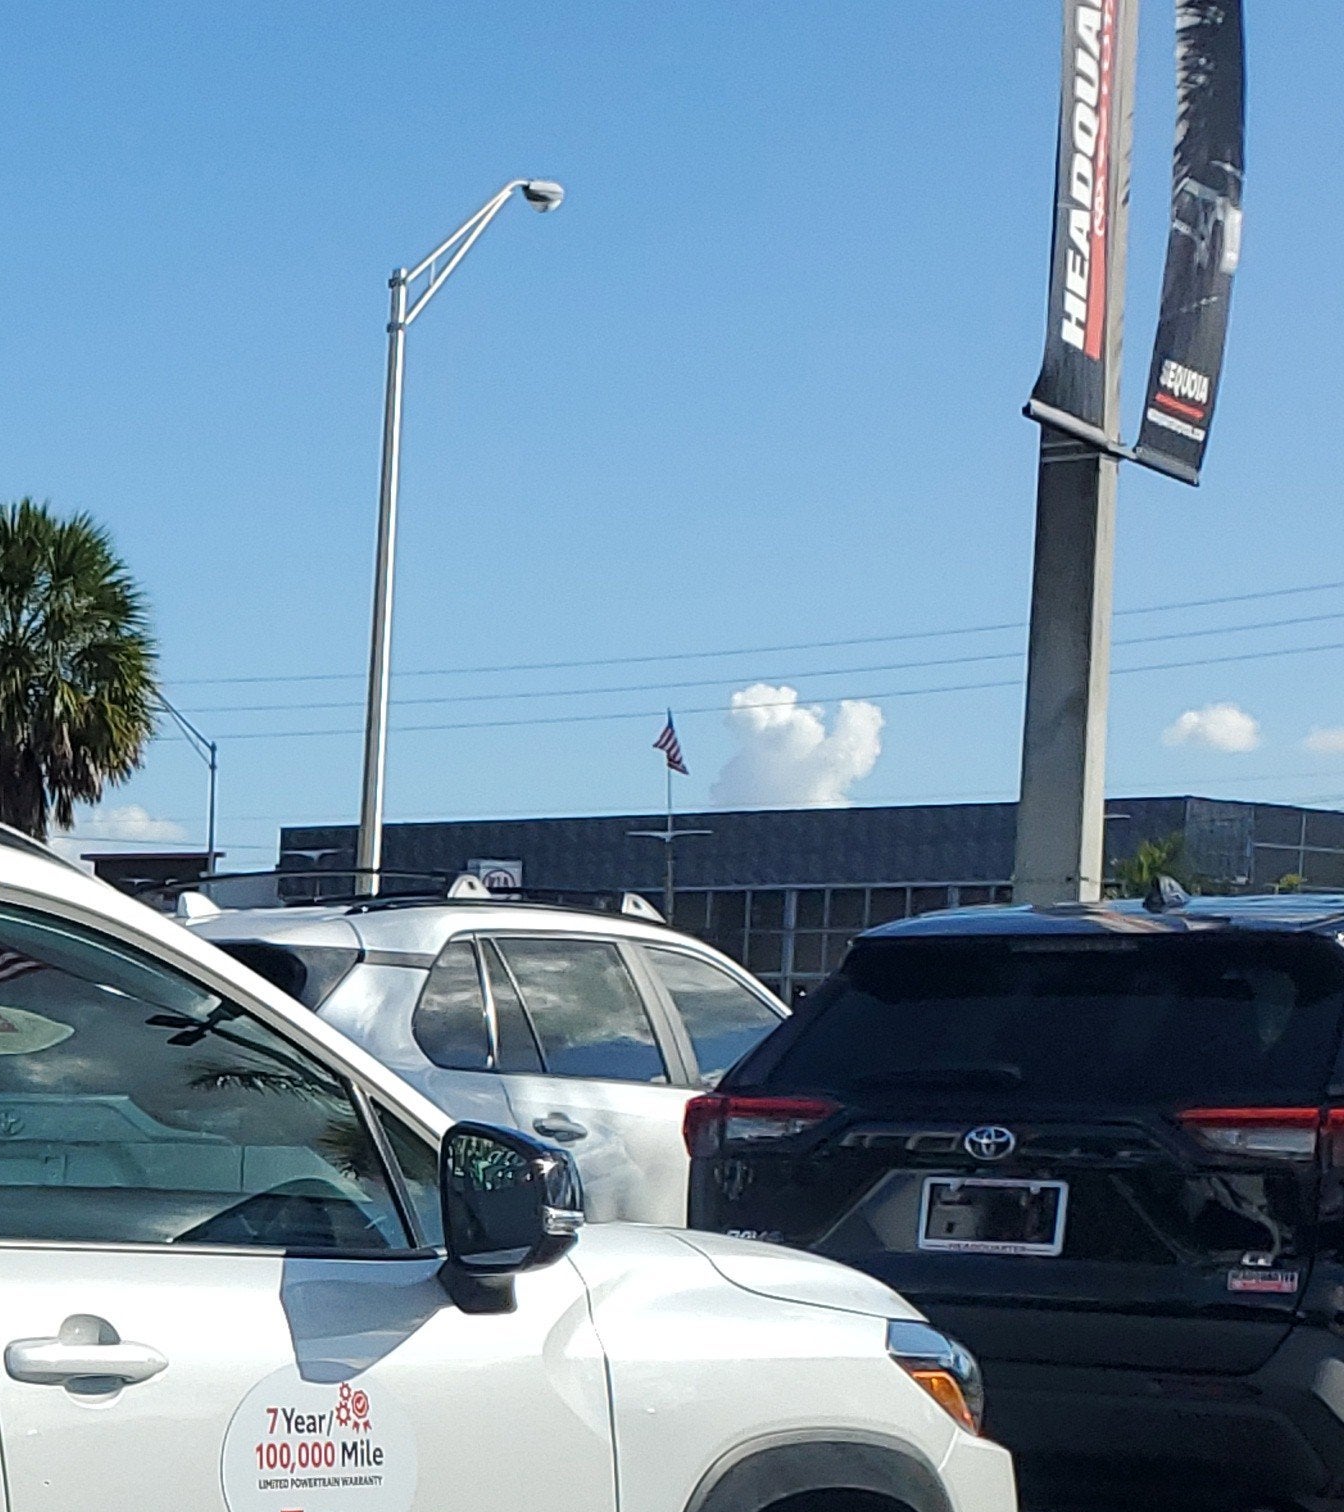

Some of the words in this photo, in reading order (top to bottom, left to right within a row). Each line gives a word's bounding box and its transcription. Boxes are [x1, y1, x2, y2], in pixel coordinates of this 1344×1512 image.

[1061, 0, 1103, 350] HEADQUA
[266, 1408, 279, 1434] 7
[255, 1441, 335, 1473] 100,000
[341, 1439, 384, 1467] Mile
[258, 1478, 289, 1490] LIMITED
[290, 1477, 340, 1489] POWERTRAIN
[341, 1475, 383, 1486] WARRANTY
